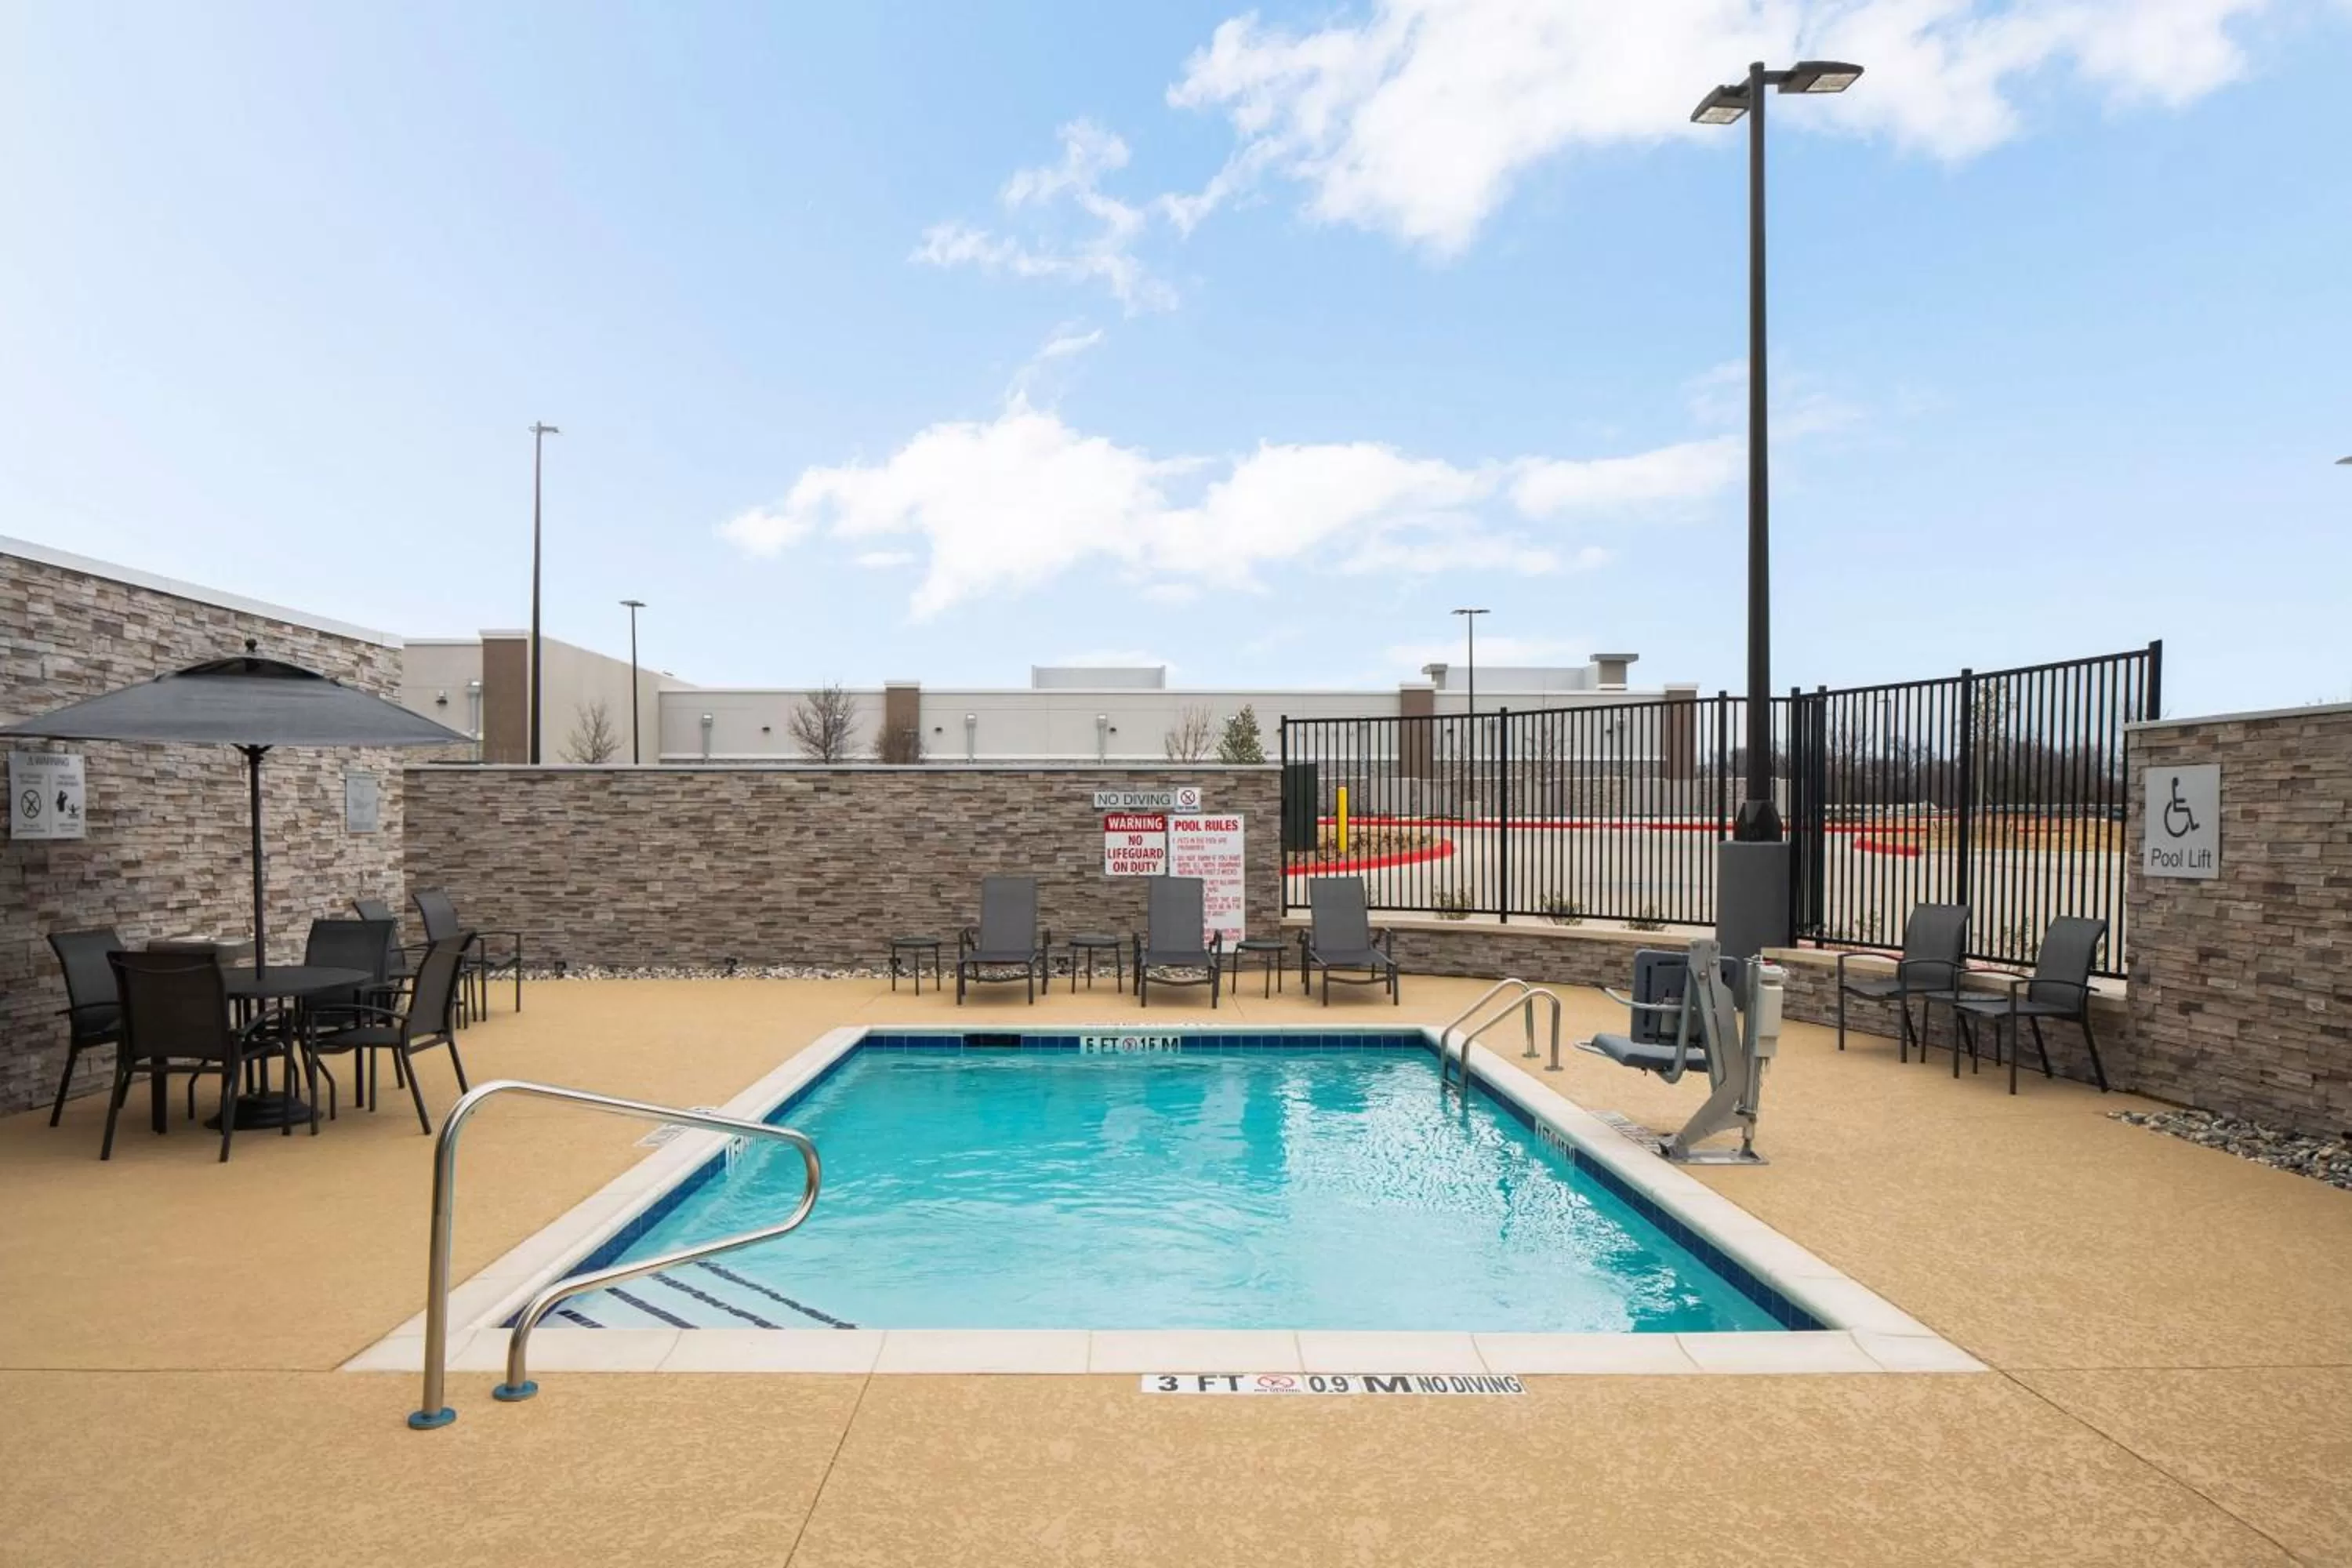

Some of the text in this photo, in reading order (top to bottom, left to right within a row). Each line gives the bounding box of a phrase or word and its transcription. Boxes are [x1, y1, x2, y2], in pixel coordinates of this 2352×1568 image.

[1098, 793, 1171, 805] NO DIVING
[1108, 816, 1163, 830] WARNING
[1174, 819, 1239, 832] POOL RULES
[1128, 834, 1143, 845] NO
[1106, 848, 1164, 859] LIFEGUARD
[2151, 848, 2212, 869] Pool Lift
[1113, 862, 1158, 873] ON DUTY
[1158, 1375, 1523, 1393] 3 FT 0.9 M NO DIVING
